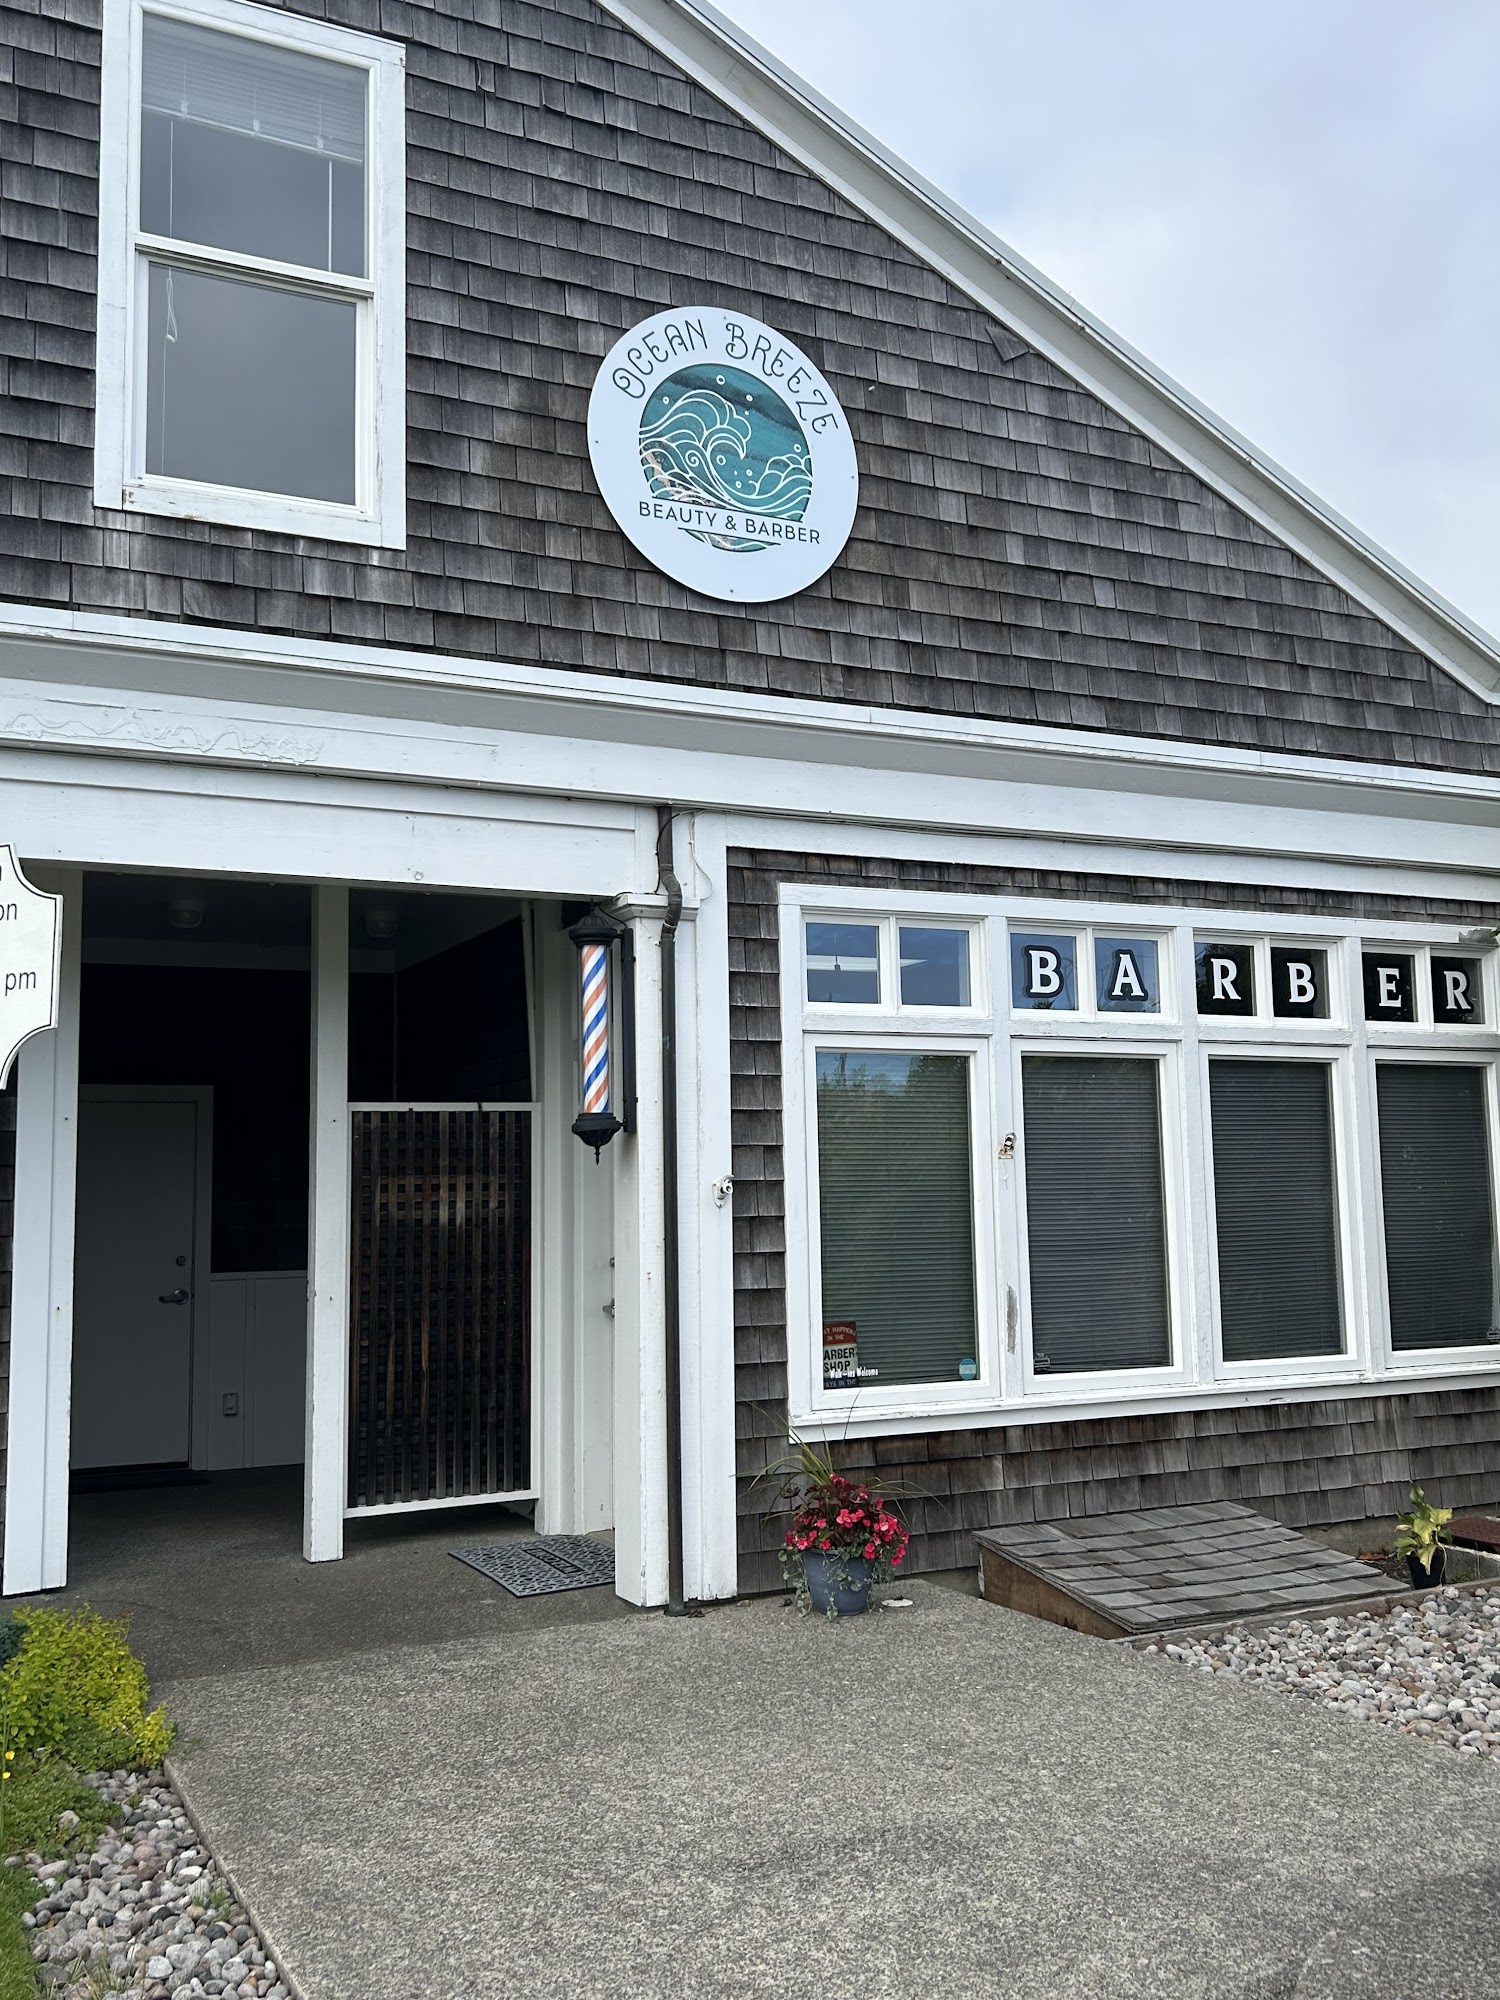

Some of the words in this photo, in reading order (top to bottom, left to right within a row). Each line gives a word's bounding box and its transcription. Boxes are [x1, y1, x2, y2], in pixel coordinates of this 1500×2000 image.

[612, 318, 708, 399] OCEAN
[725, 322, 839, 435] BREEZE
[639, 501, 717, 527] BEAUTY
[725, 515, 738, 531] &
[745, 518, 821, 545] BARBER
[5, 971, 37, 996] pm
[1029, 949, 1472, 1011] BARBER
[823, 1361, 850, 1373] SHOP
[856, 1366, 879, 1377] Welcome
